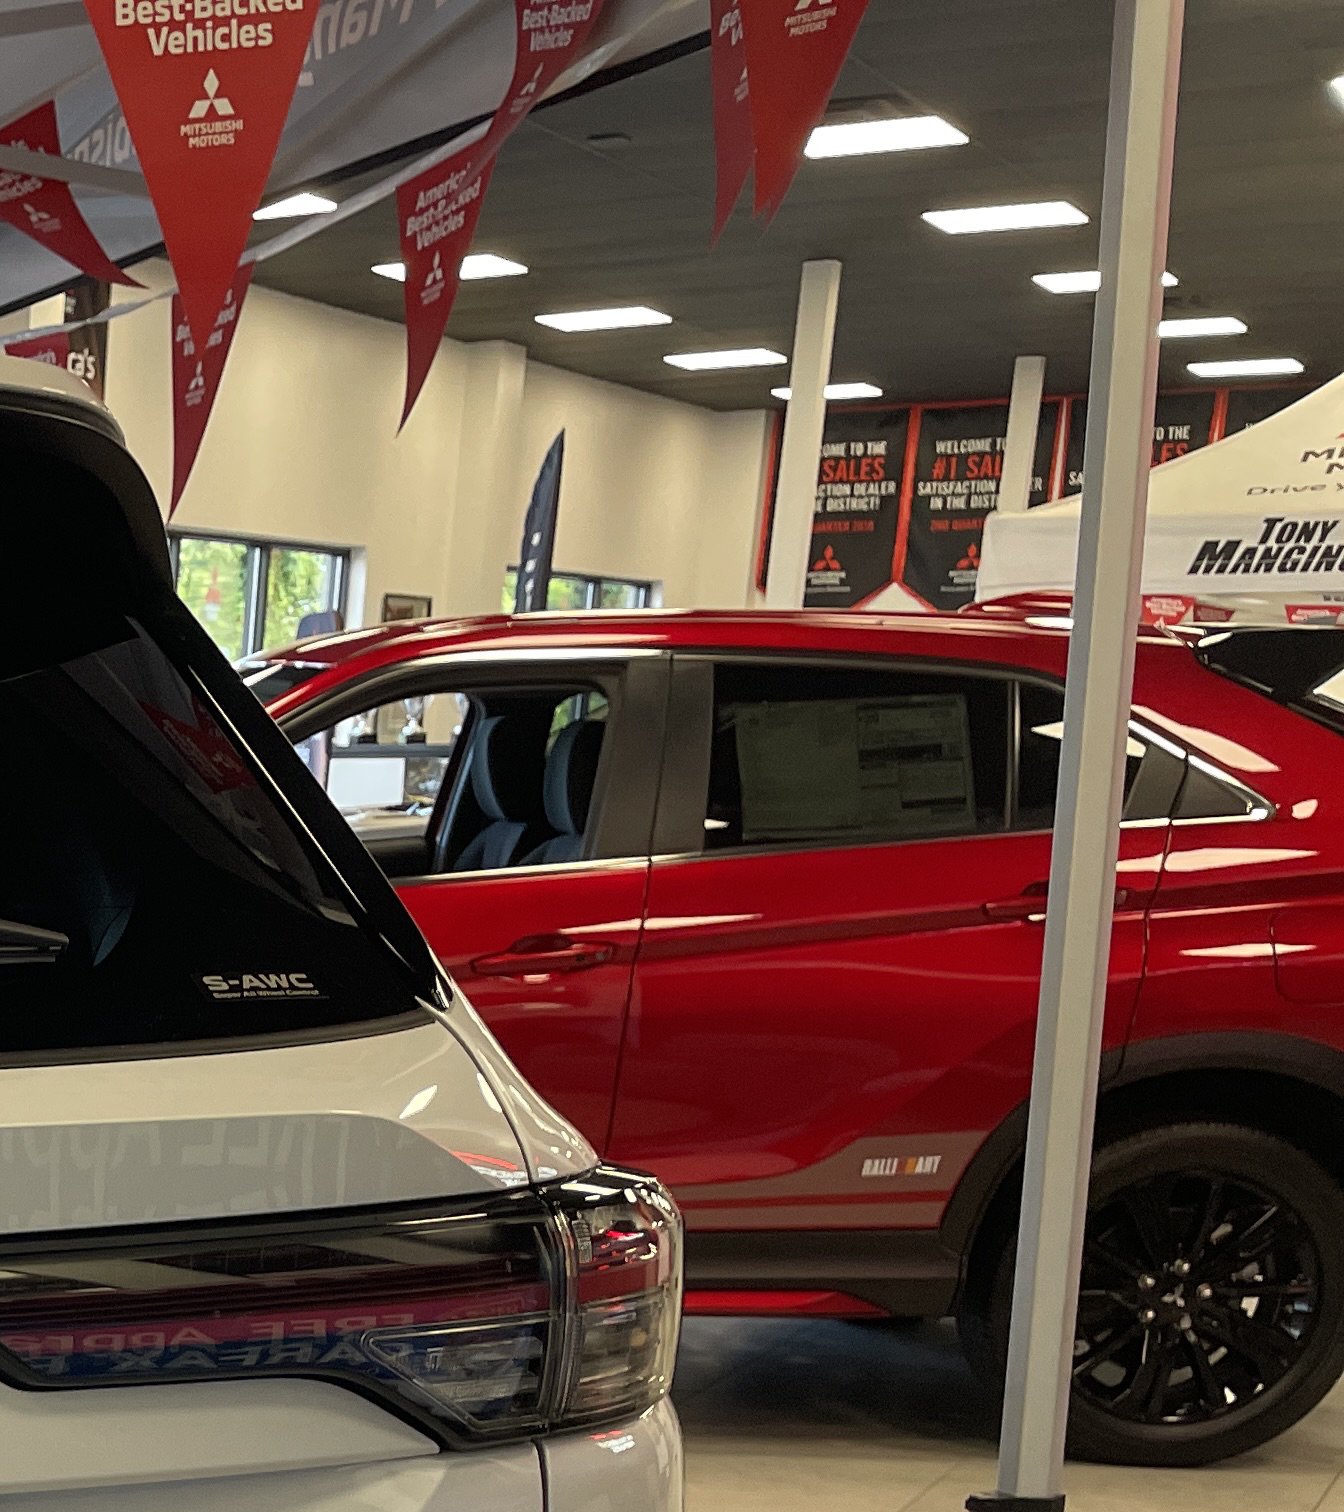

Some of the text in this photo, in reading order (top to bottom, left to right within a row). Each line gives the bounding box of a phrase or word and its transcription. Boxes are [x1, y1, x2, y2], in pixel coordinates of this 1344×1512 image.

[147, 19, 273, 56] Vehicles
[180, 119, 243, 137] MITSUBISHI
[188, 133, 235, 149] MOTORS
[1167, 425, 1191, 441] THE
[935, 438, 993, 454] WELCOME
[822, 457, 886, 482] SALES
[932, 454, 958, 479] #1
[853, 480, 897, 498] DEALER
[917, 479, 997, 496] SATISFACTION
[1246, 483, 1327, 496] Drive
[930, 495, 944, 511] IN
[947, 495, 967, 511] THE
[1258, 517, 1340, 546] TONY
[202, 973, 314, 990] S-AWC
